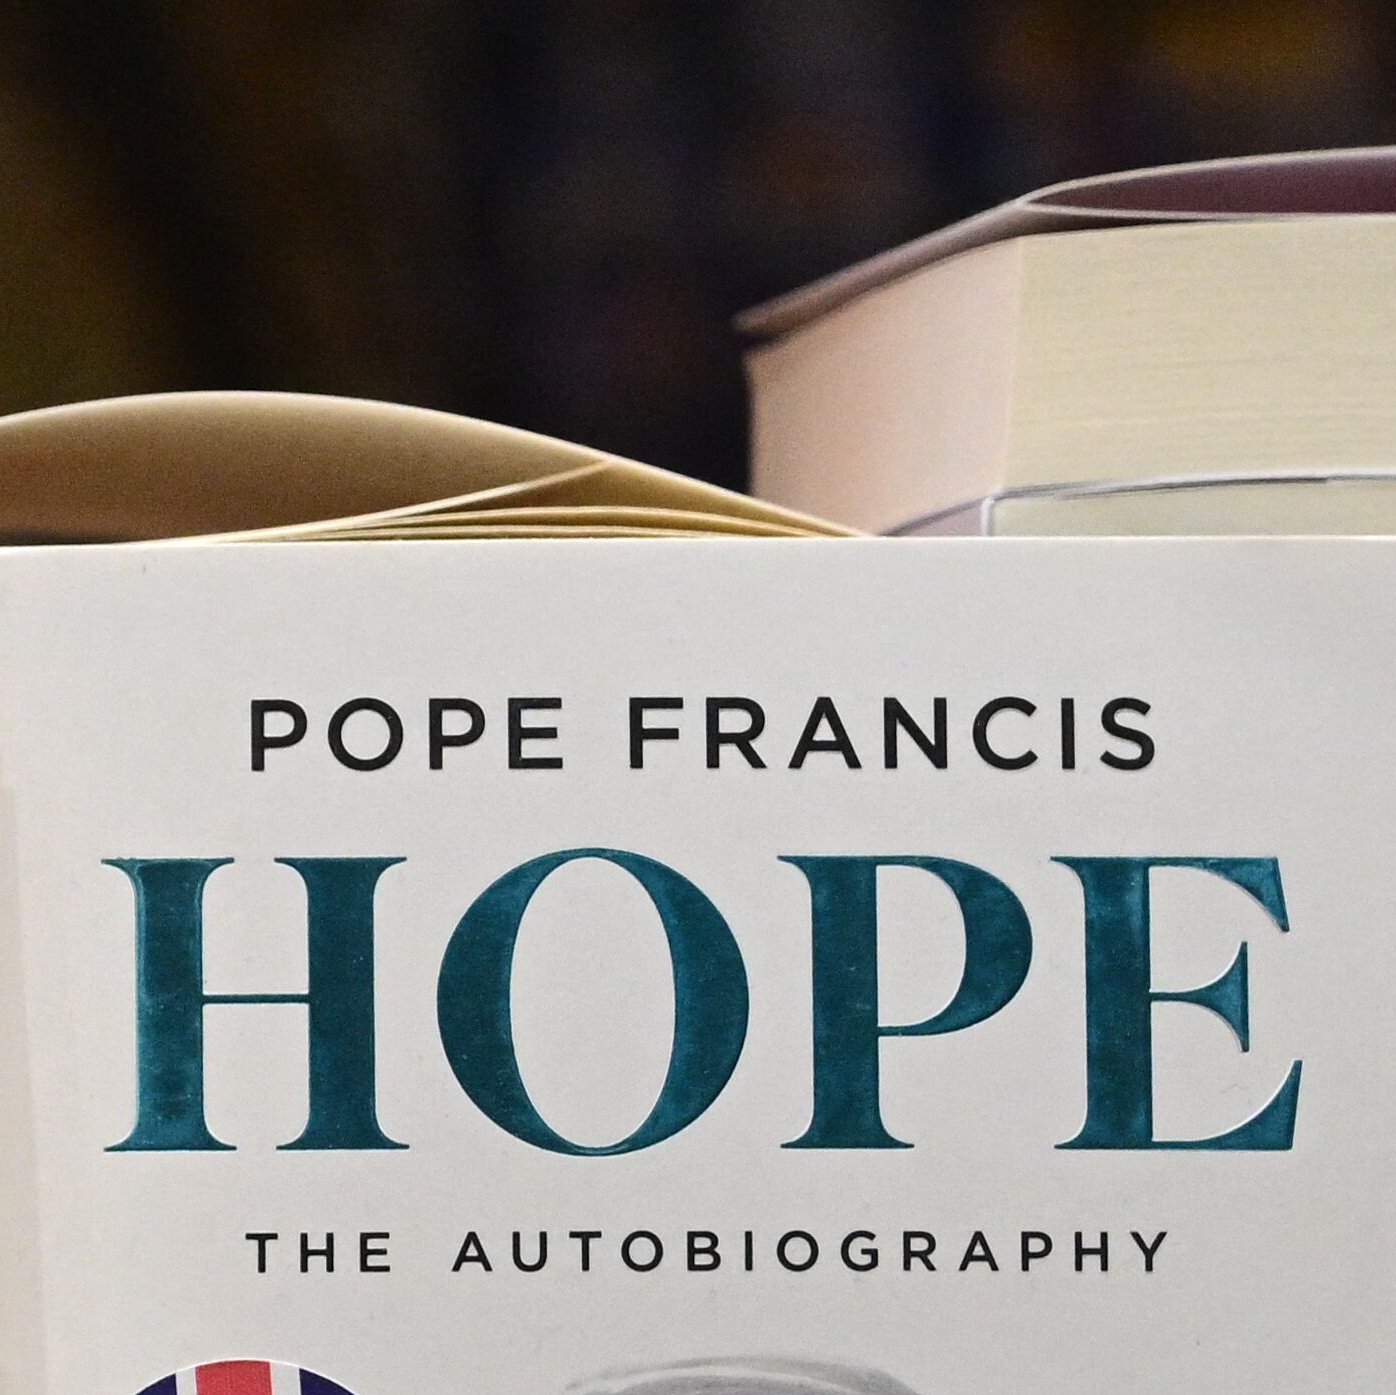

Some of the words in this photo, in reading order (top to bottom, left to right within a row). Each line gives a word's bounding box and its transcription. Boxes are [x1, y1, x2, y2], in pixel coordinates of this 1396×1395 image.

[251, 698, 562, 771] POPE
[630, 697, 1154, 770] FRANCIS
[102, 848, 1302, 1156] HOPE
[246, 1233, 390, 1273] THE
[452, 1231, 1166, 1272] AUTOBIOGRAPHY
